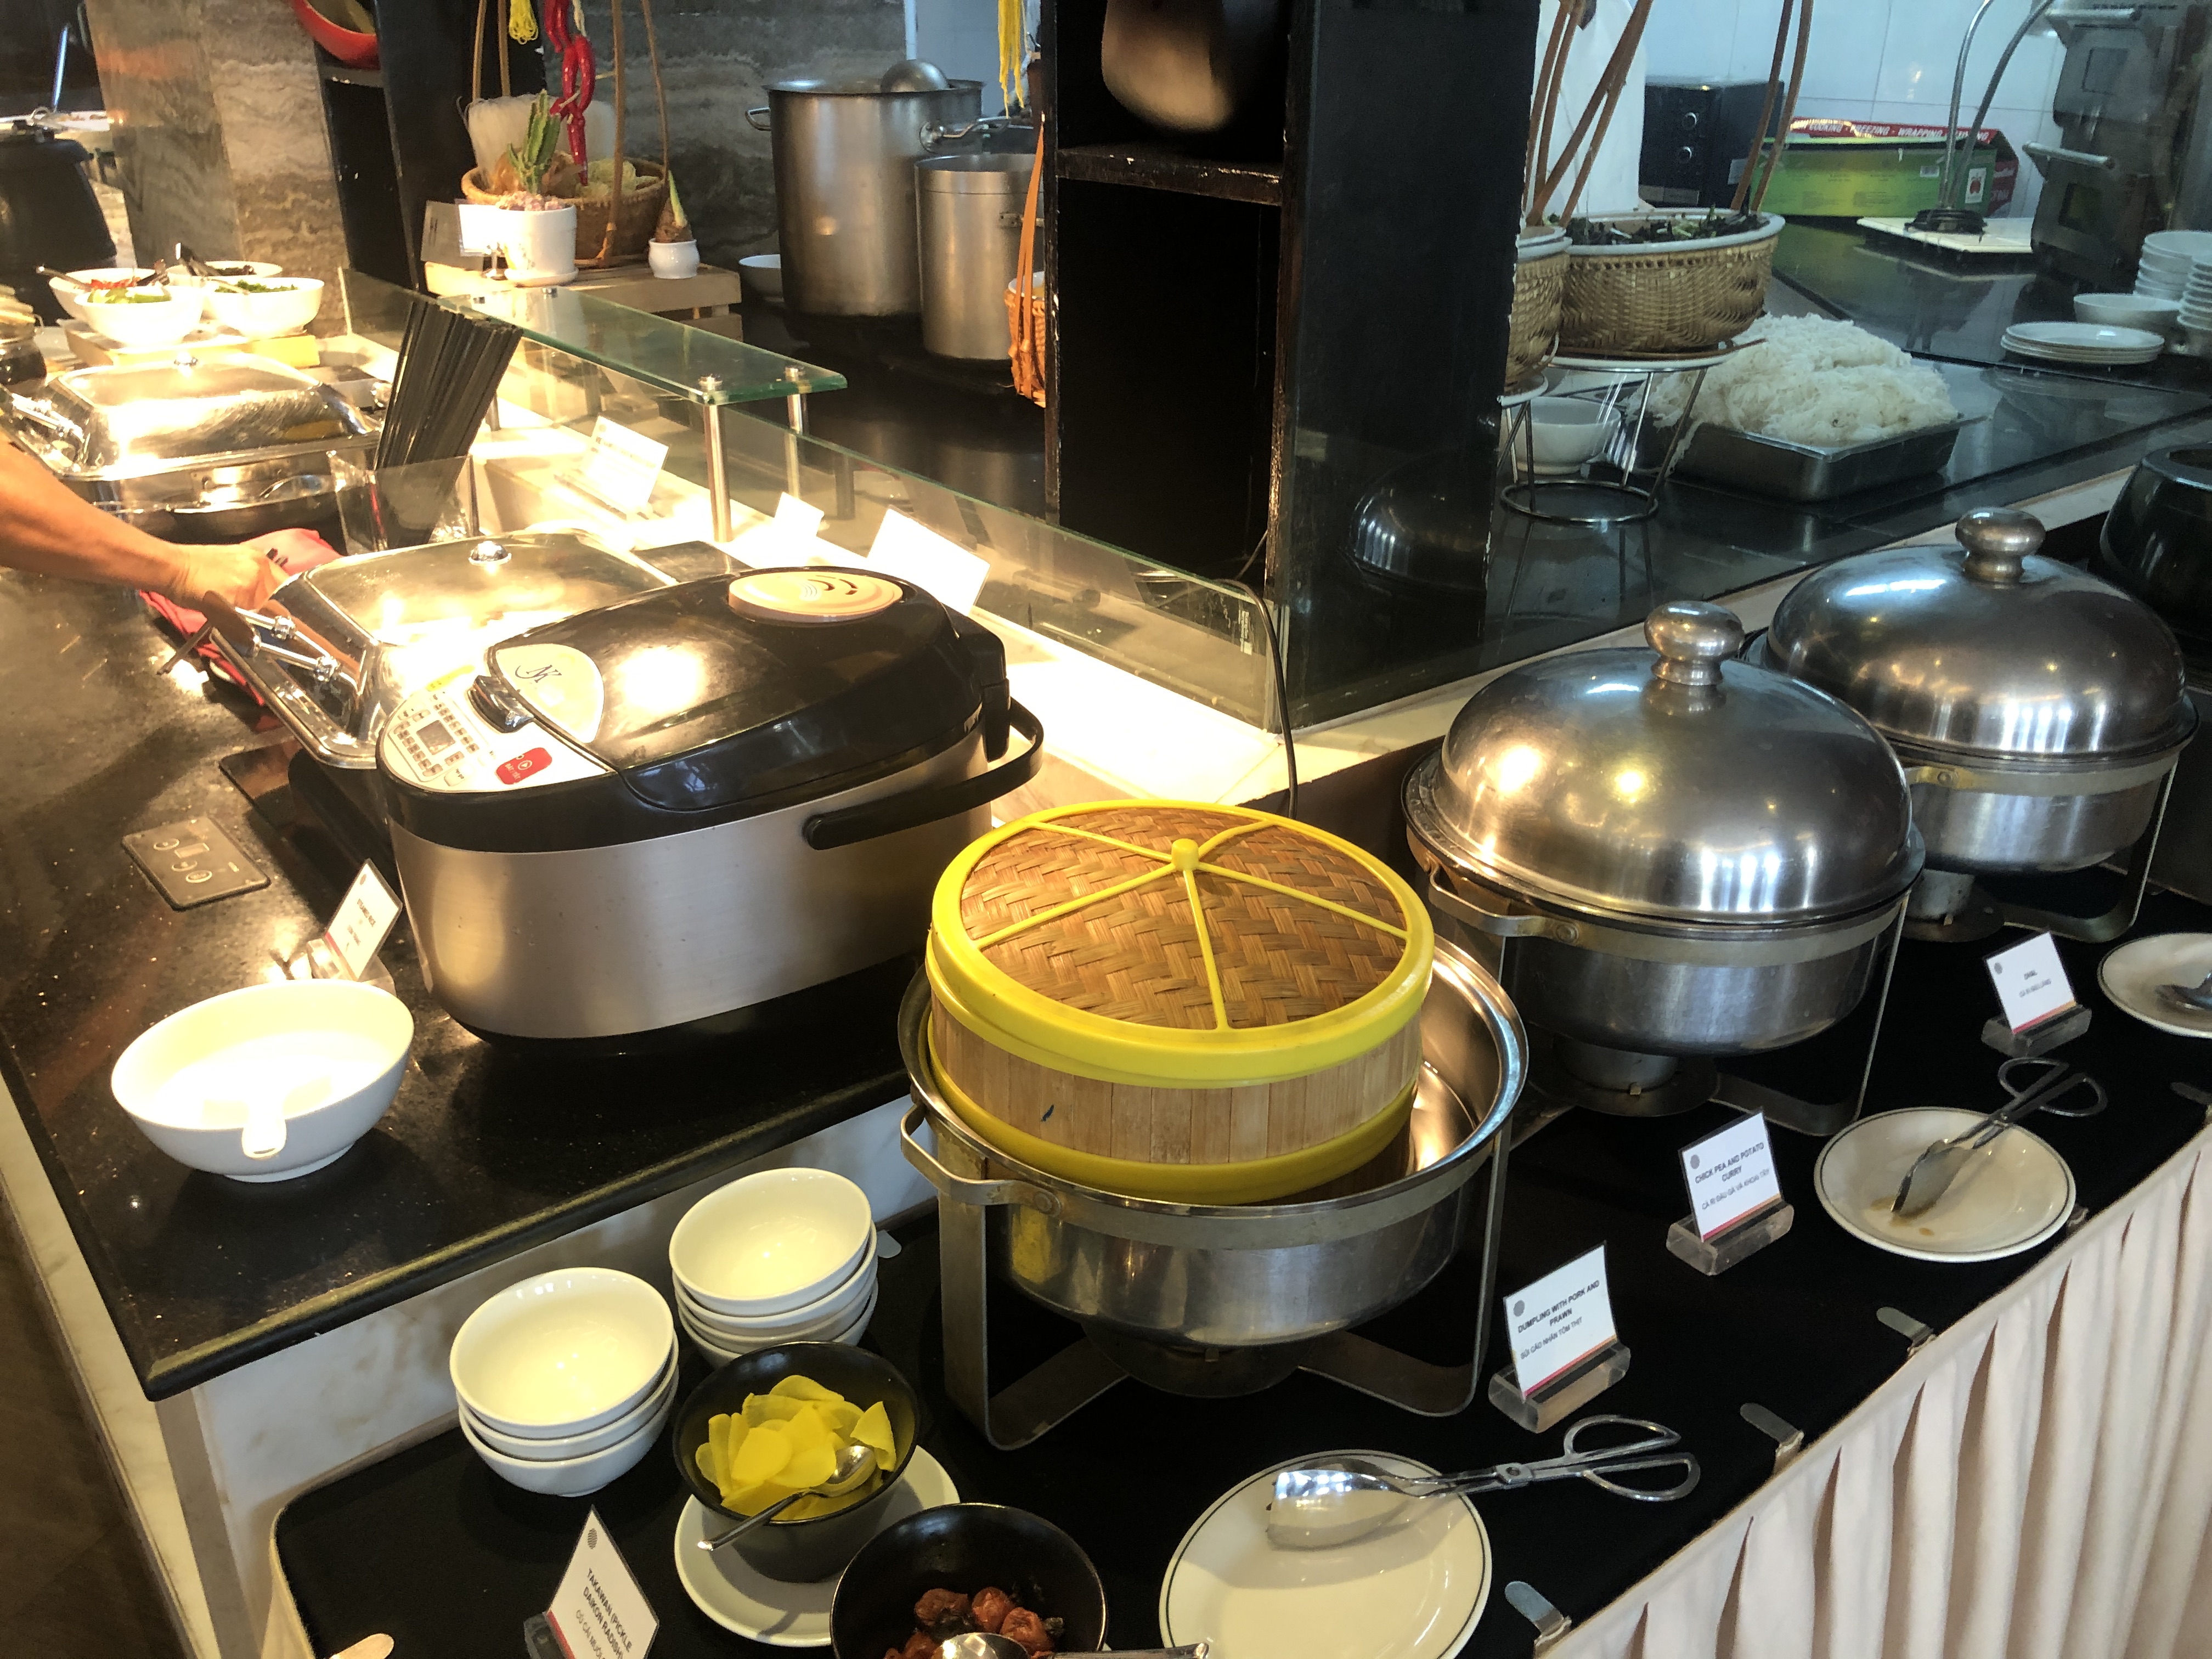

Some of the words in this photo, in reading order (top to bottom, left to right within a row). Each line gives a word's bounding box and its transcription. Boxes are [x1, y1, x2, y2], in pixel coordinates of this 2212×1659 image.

[1898, 127, 1943, 137] WRAPPING
[1695, 1169, 1713, 1183] CHICK
[1714, 1163, 1726, 1173] PEA
[1728, 1155, 1740, 1166] AND
[1741, 1142, 1764, 1159] POTATO
[1722, 1166, 1742, 1182] CURRY
[1518, 1309, 1550, 1333] DUMPLING
[1551, 1299, 1567, 1312] WITH
[1568, 1288, 1585, 1303] PORK
[1587, 1280, 1600, 1292] AND
[1549, 1308, 1572, 1326] PRAWN
[583, 1587, 603, 1624] DAIKON
[587, 1568, 612, 1616] TAKAWAN
